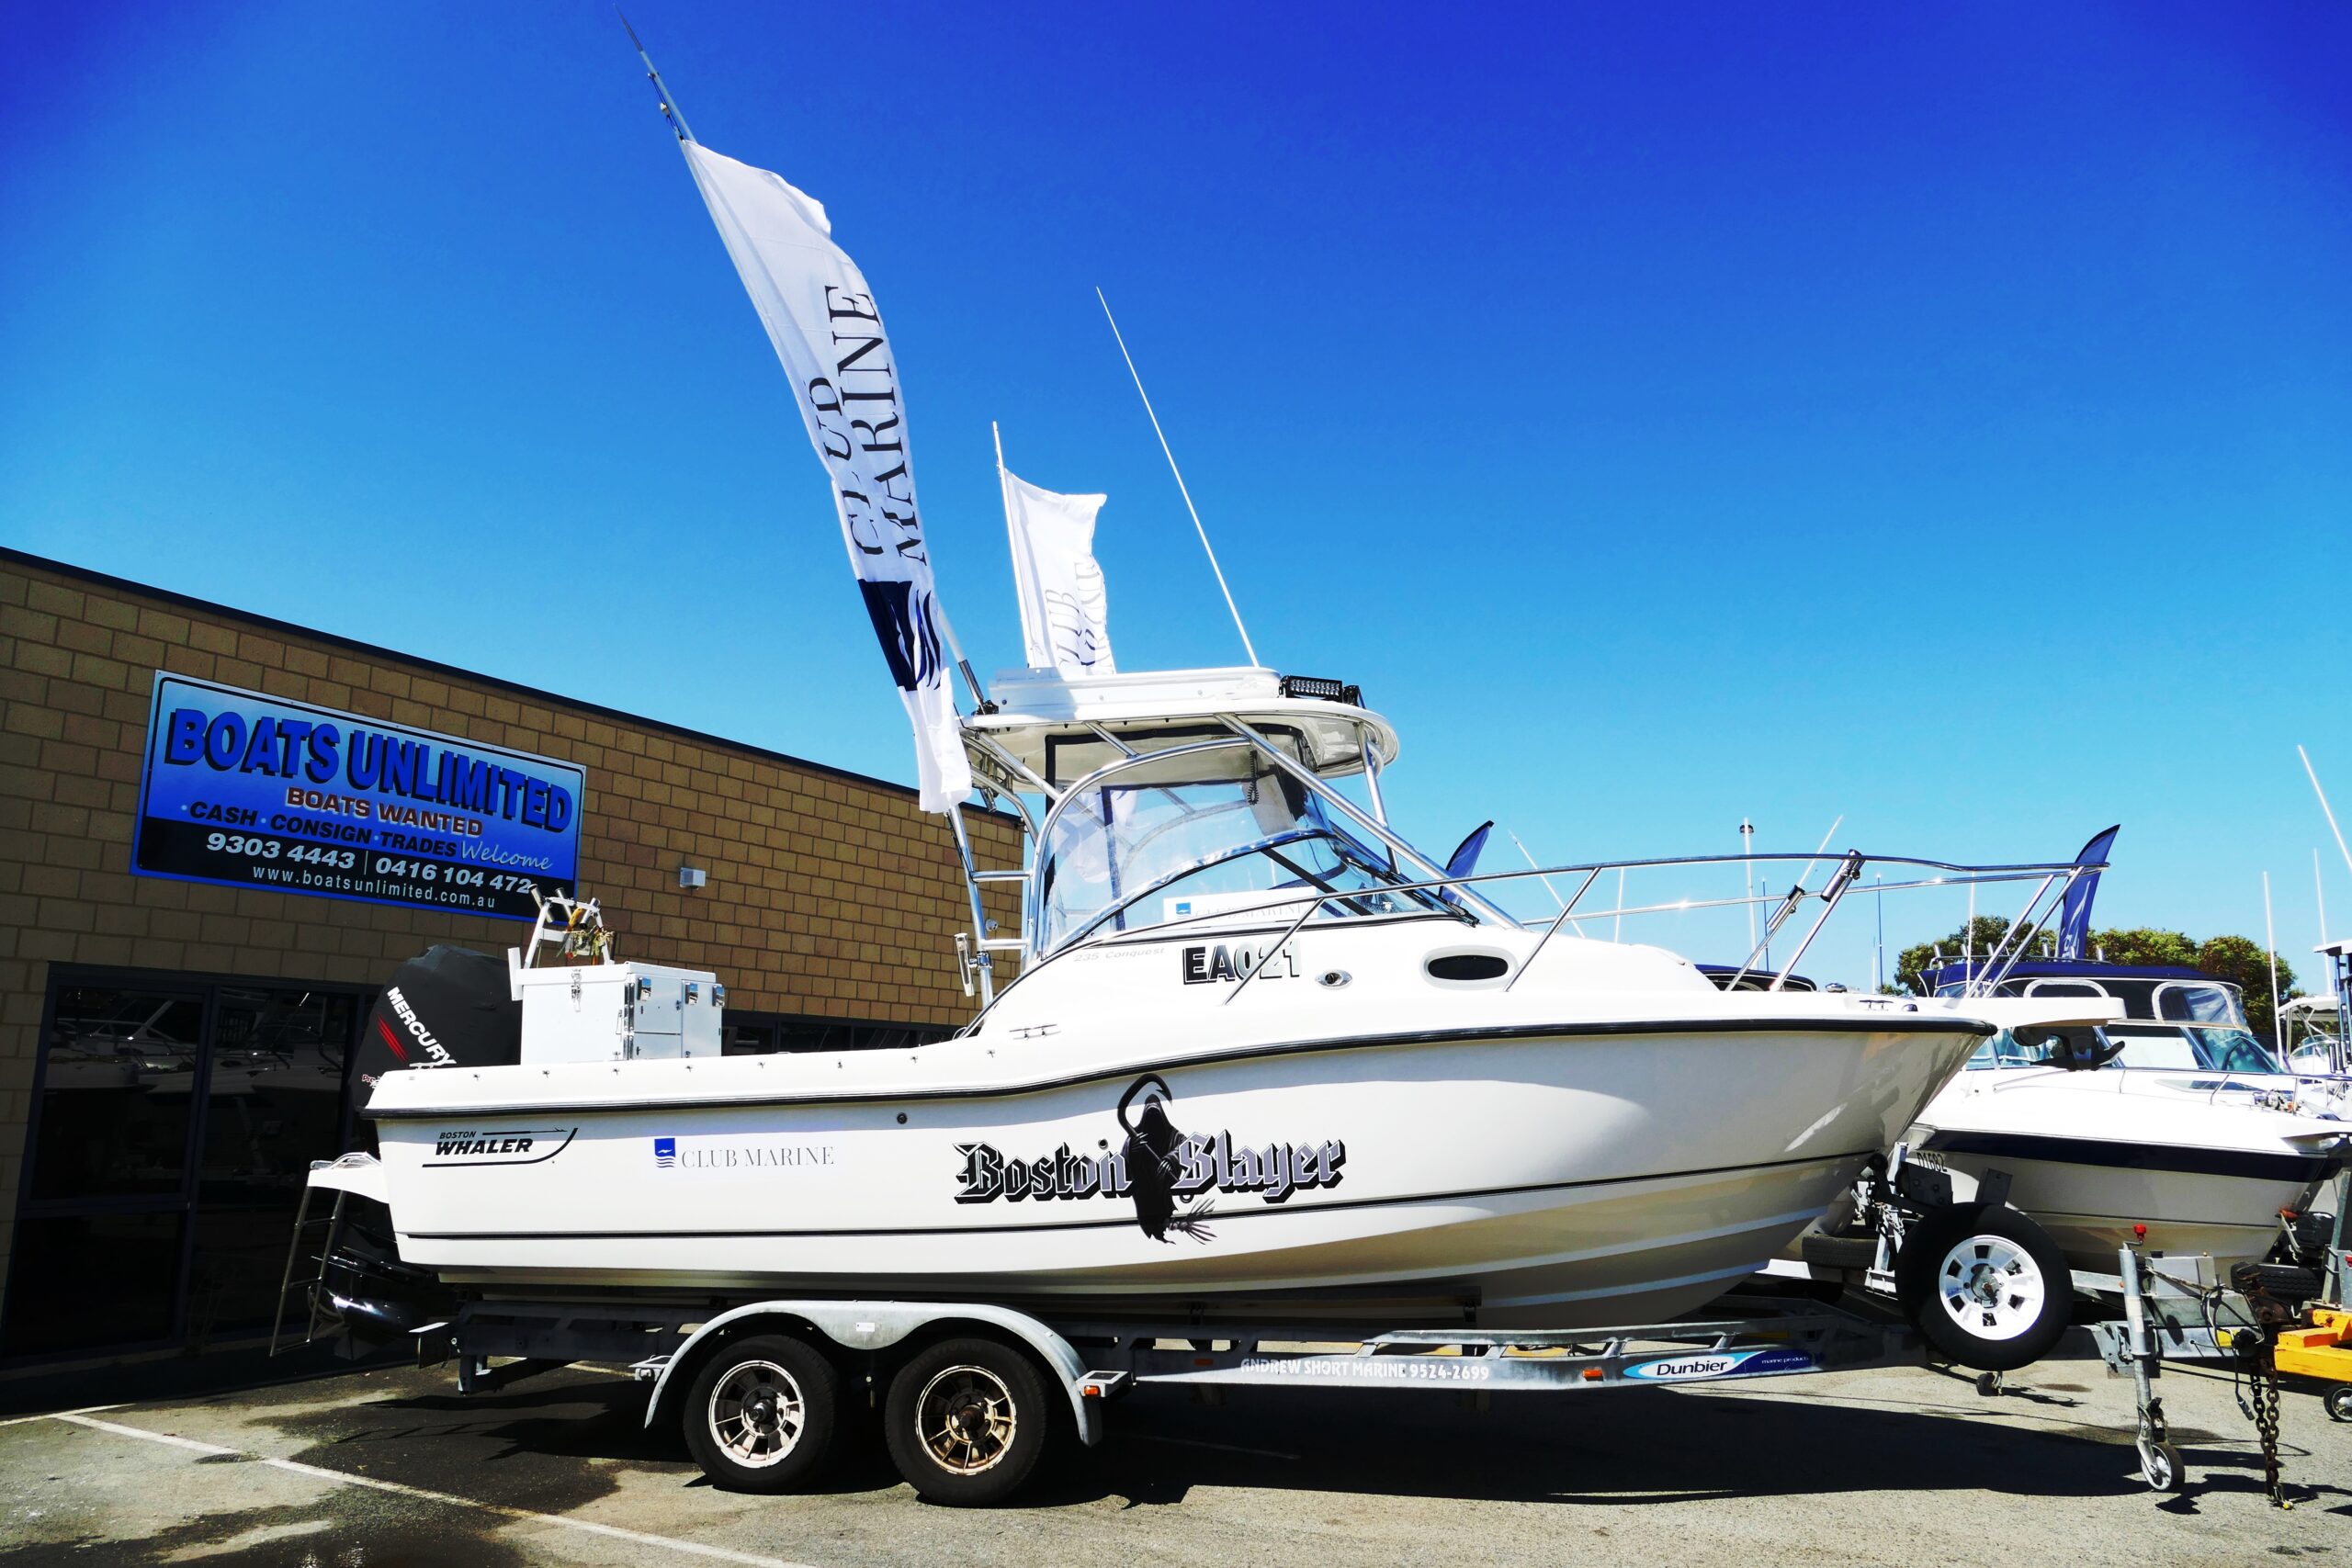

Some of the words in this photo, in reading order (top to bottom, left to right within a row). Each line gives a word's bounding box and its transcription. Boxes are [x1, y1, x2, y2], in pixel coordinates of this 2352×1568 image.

[824, 285, 927, 567] MARINE
[164, 708, 341, 784] BOATS
[346, 730, 572, 833] UNLIMITED
[189, 801, 258, 827] CASH
[270, 814, 372, 844] CONSIGN
[380, 831, 457, 857] TRADES
[461, 840, 553, 871] Welcome
[286, 786, 371, 818] BOATS
[378, 803, 483, 838] WANTED
[207, 832, 280, 858] 9303
[287, 845, 356, 869] 4443
[375, 857, 437, 881] 0416
[444, 867, 483, 887] 104
[490, 874, 531, 895] 472
[253, 866, 495, 908] www.boatsunlimited.com.au
[1073, 952, 1100, 962] 235
[1105, 947, 1165, 959] Conquest
[1182, 937, 1301, 985] EA021
[387, 987, 457, 1066] MERCURY
[435, 1138, 533, 1156] WHALER
[439, 1131, 476, 1139] BOSTON
[682, 1149, 737, 1168] CLUB
[745, 1146, 834, 1167] MARINE
[953, 1141, 1134, 1204] Boston
[1171, 1129, 1347, 1203] Slayer
[1240, 1358, 1301, 1374] ANDREW
[1304, 1360, 1350, 1376] SHORT
[1351, 1361, 1406, 1377] MARINE
[1410, 1364, 1489, 1380] 9524-2699
[1657, 1360, 1727, 1375] Dunbier
